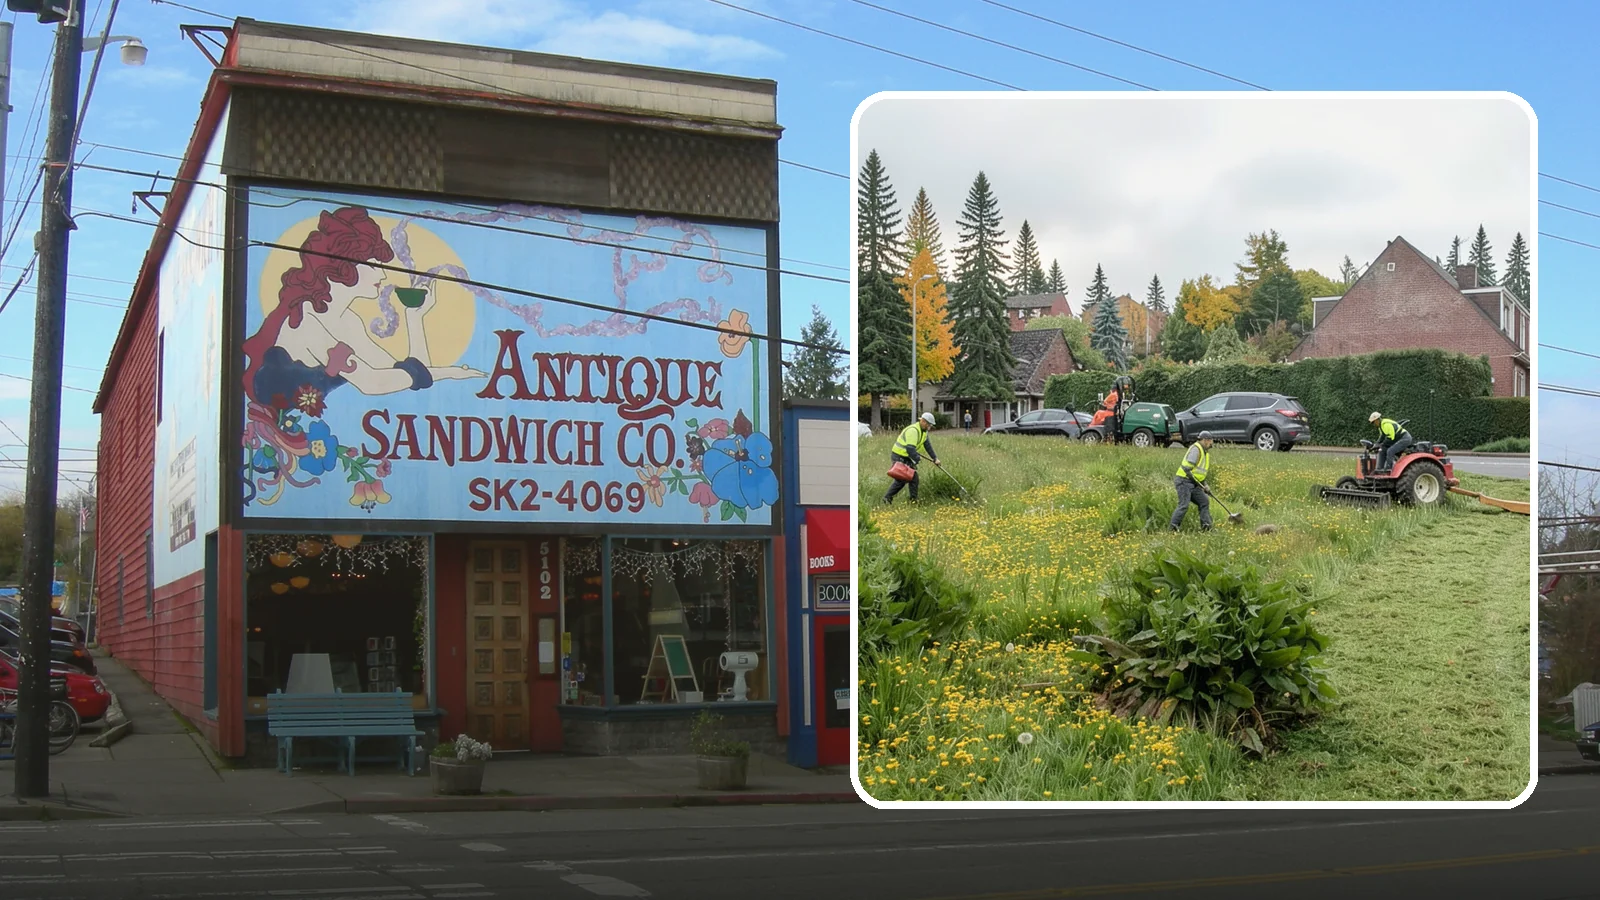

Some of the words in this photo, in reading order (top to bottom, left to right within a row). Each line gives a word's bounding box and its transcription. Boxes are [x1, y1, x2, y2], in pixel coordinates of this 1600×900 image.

[476, 329, 723, 420] ANTIQUE
[362, 409, 604, 467] SANDWICH
[616, 421, 685, 470] CO.
[468, 476, 646, 514] SK2-4069
[540, 542, 552, 598] 5102
[809, 555, 835, 569] BOOKS
